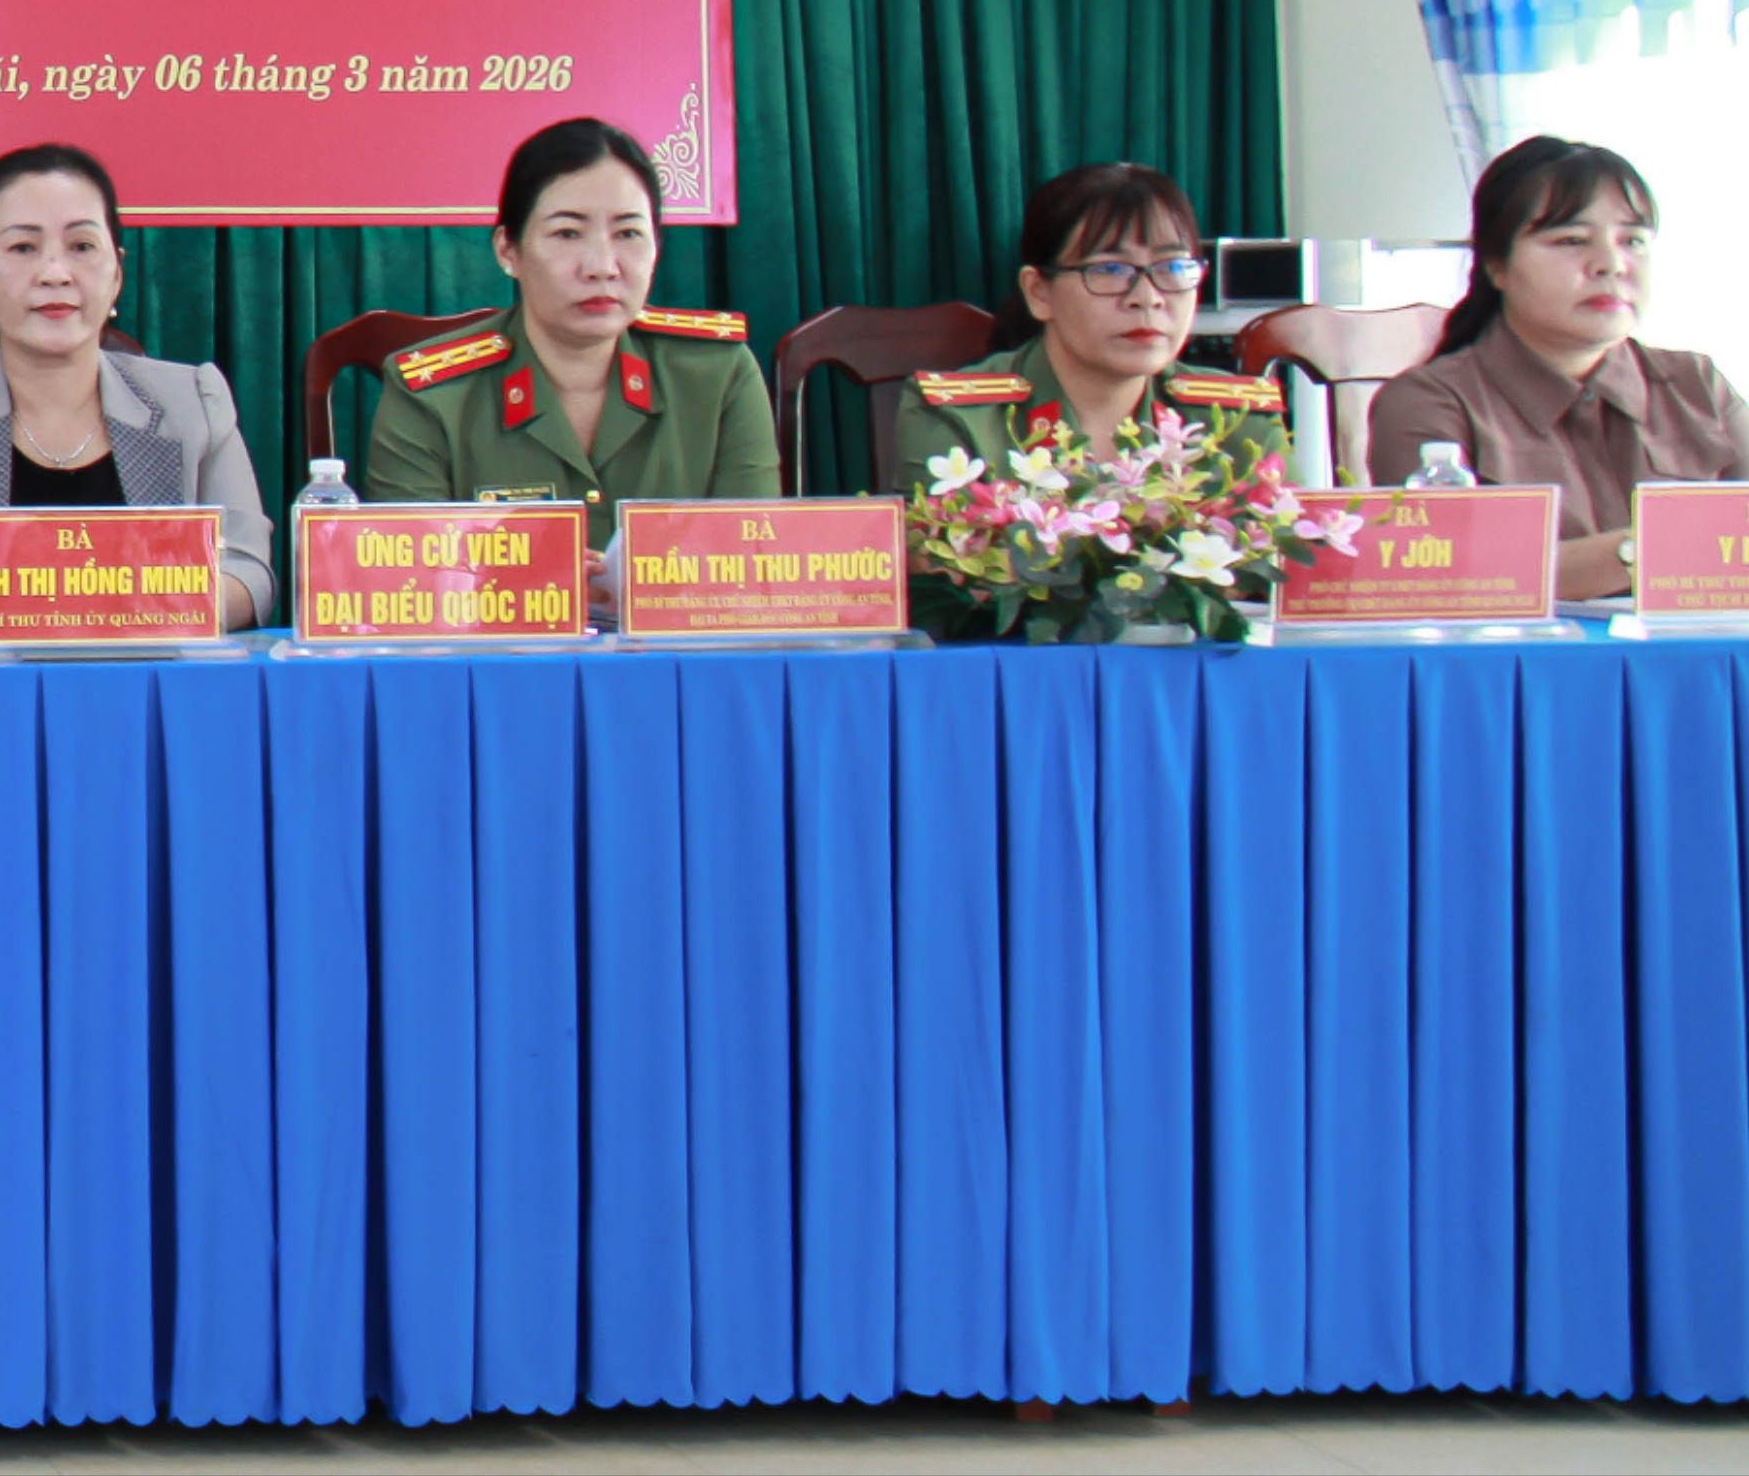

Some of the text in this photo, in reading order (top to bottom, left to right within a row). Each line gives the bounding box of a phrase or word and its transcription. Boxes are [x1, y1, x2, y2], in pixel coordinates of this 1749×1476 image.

[42, 54, 145, 100] ngày
[155, 54, 202, 91] 06
[215, 54, 336, 100] tháng
[344, 55, 369, 91] 3
[379, 56, 468, 91] năm
[479, 55, 573, 91] 2026
[57, 523, 93, 549] BÀ
[356, 523, 531, 568] ỨNG CỬ VIÊN
[742, 512, 776, 540] BÀ
[17, 568, 56, 601] THỊ
[64, 558, 133, 595] HỒNG
[141, 566, 208, 594] MINH
[633, 546, 892, 588] TRẦN THỊ THU PHƯỚC
[8, 614, 41, 627] THƯ
[45, 610, 82, 627] TỈNH
[86, 611, 106, 626] ỦY
[110, 610, 164, 627] QUẢNG
[316, 578, 571, 633] ĐẠI BIỂU QUỐC HỘI
